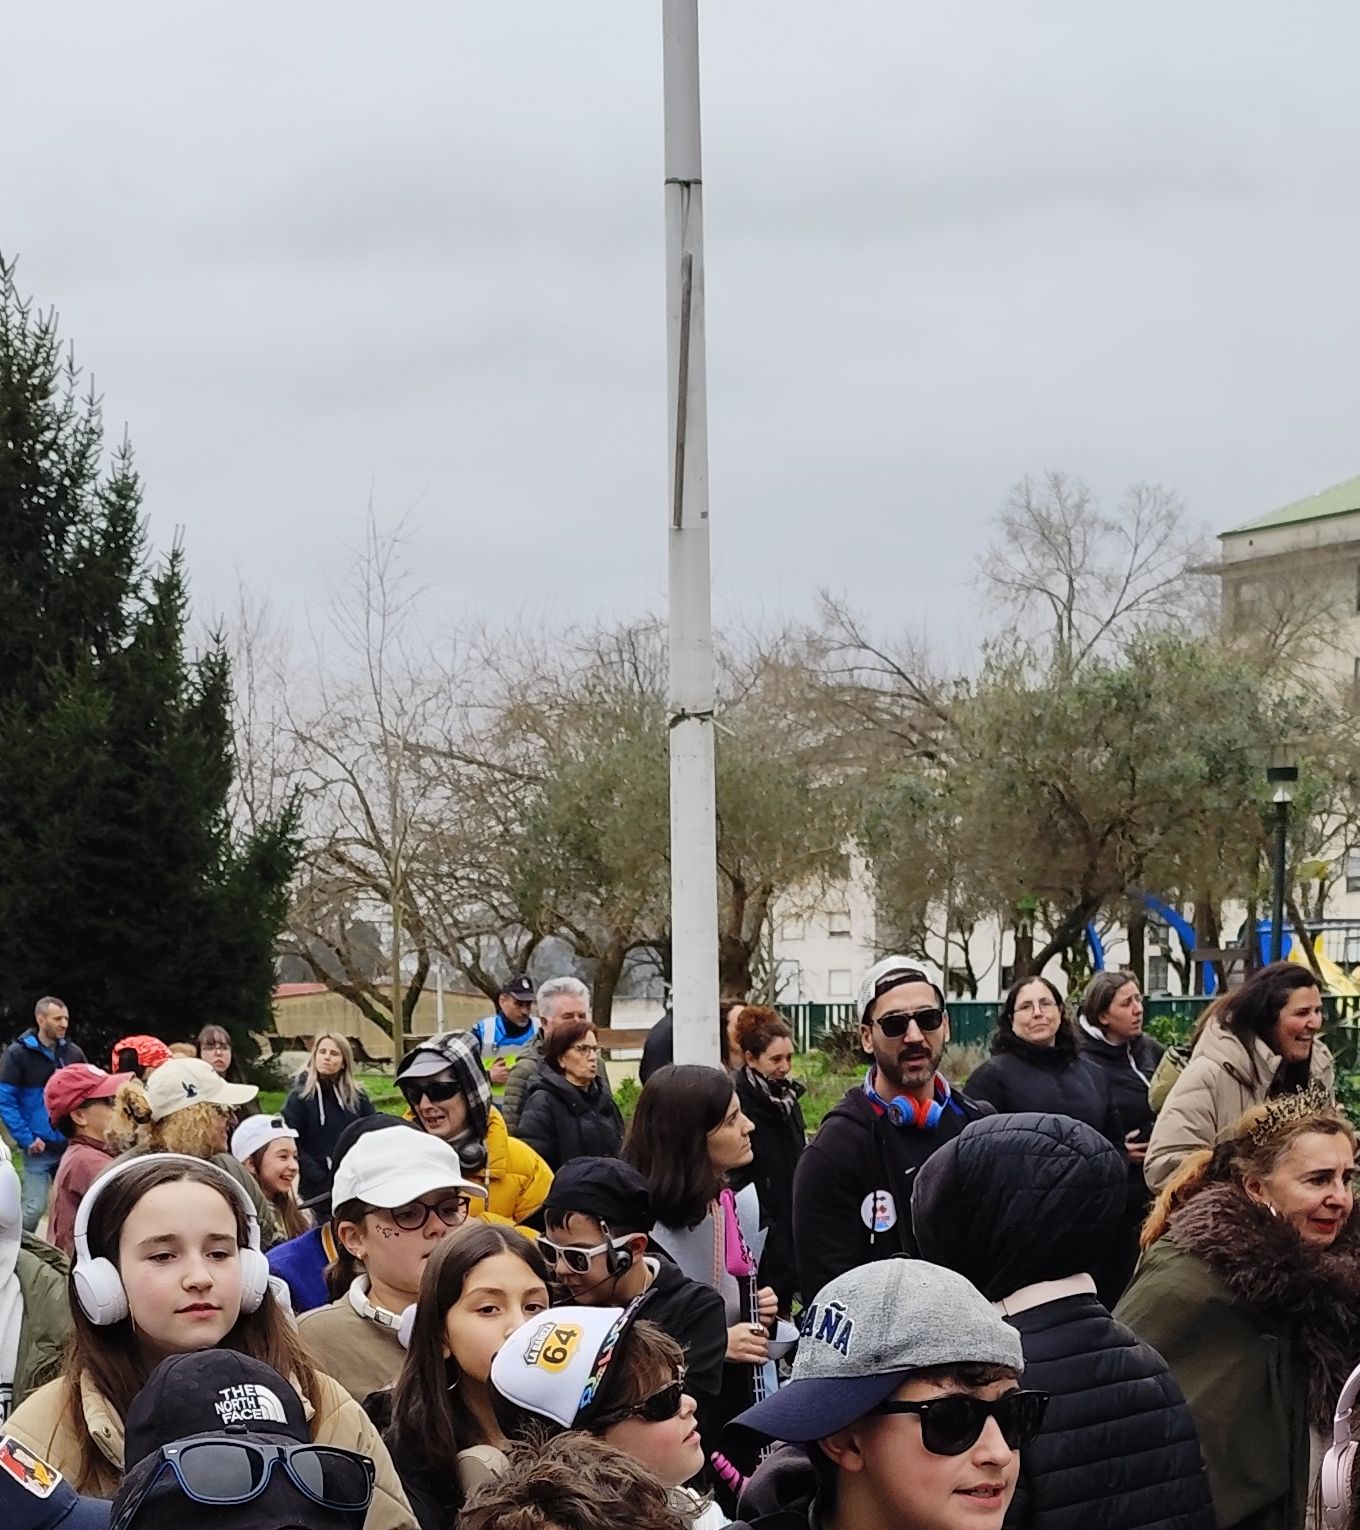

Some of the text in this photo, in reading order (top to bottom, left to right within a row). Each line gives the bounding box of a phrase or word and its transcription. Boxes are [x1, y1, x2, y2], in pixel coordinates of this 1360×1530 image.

[542, 1328, 578, 1364] 64
[218, 1384, 257, 1401] THE
[214, 1396, 257, 1415] NORTH
[221, 1408, 264, 1425] FACE
